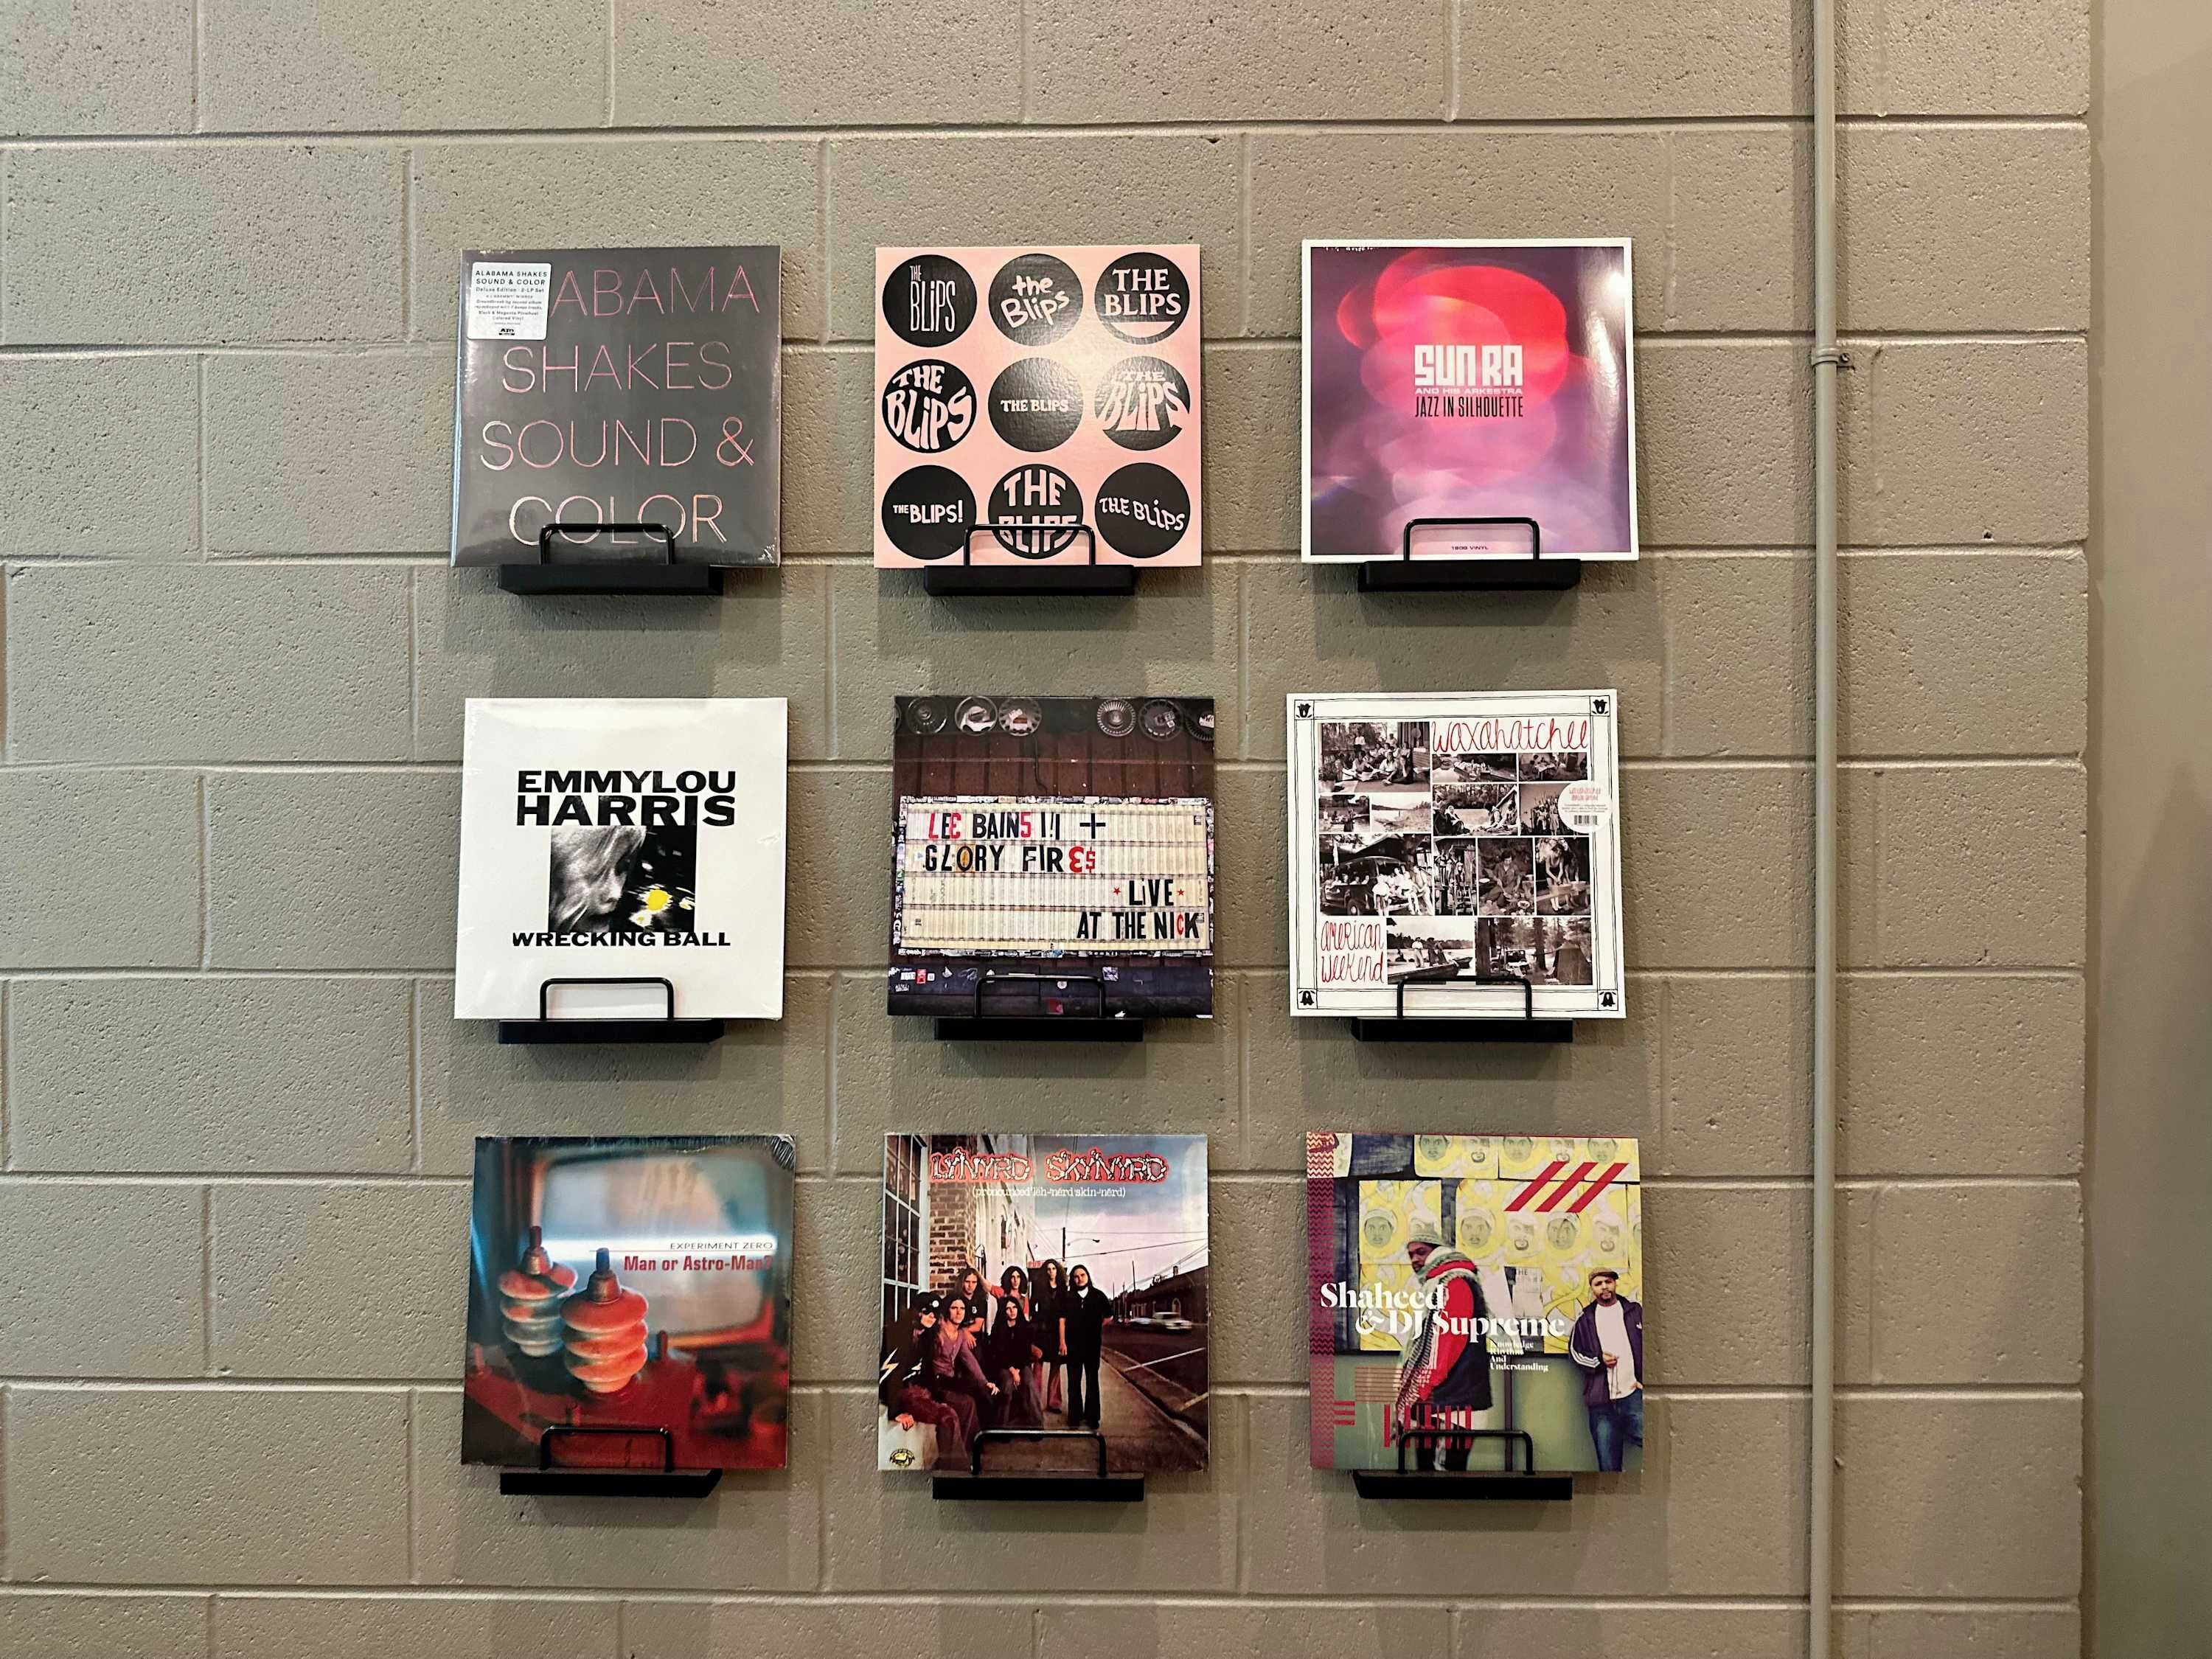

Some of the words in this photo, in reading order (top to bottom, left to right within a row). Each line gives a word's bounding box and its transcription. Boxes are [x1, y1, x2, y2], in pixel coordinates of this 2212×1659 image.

[910, 265, 922, 282] THE
[1012, 275, 1054, 296] the
[1111, 268, 1171, 291] THE
[550, 265, 760, 317] ABAMA
[1104, 293, 1181, 317] BLIPS
[1000, 290, 1070, 329] Blips
[502, 341, 733, 394] SHAKES
[1120, 370, 1166, 382] THE
[1414, 344, 1476, 386] SUN
[1481, 344, 1523, 386] RA
[892, 365, 945, 394] THE
[1000, 399, 1028, 413] THE
[1030, 399, 1069, 413] BLIPS
[1415, 396, 1439, 418] JAZZ
[1443, 396, 1454, 417] IN
[1458, 396, 1524, 418] SILHOUETTE
[480, 417, 697, 471] SOUND
[716, 416, 755, 467] &
[1003, 468, 1066, 507] THE
[509, 494, 727, 547] COLOR
[893, 504, 909, 515] THE
[910, 499, 963, 524] BLIPS!
[1099, 497, 1130, 516] THE
[998, 515, 1078, 554] BLIPS
[1430, 717, 1588, 753] waxahatchee
[517, 770, 737, 793] EMMYLOU
[516, 795, 736, 827] HARRIS
[928, 811, 962, 839] LEE
[924, 844, 1005, 872] GLORY
[512, 931, 655, 947] WRECKING
[663, 931, 731, 947] BALL
[1077, 911, 1102, 939] AT
[1112, 911, 1147, 939] THE
[1154, 911, 1200, 939] NICK
[1321, 951, 1385, 984] weekend
[931, 1148, 1032, 1180] LYNYRD
[1046, 1149, 1167, 1181] SKYNYRD
[669, 1242, 739, 1250] EXPERIMENT
[624, 1255, 656, 1271] Man
[661, 1259, 678, 1271] or
[683, 1255, 773, 1271] Astro-Man?
[1320, 1281, 1448, 1311] Shaheed
[1354, 1309, 1385, 1336] &
[1388, 1310, 1425, 1340] DJ
[1431, 1309, 1566, 1343] Supreme
[1489, 1362, 1549, 1373] Understanding
[1490, 1354, 1507, 1363] And
